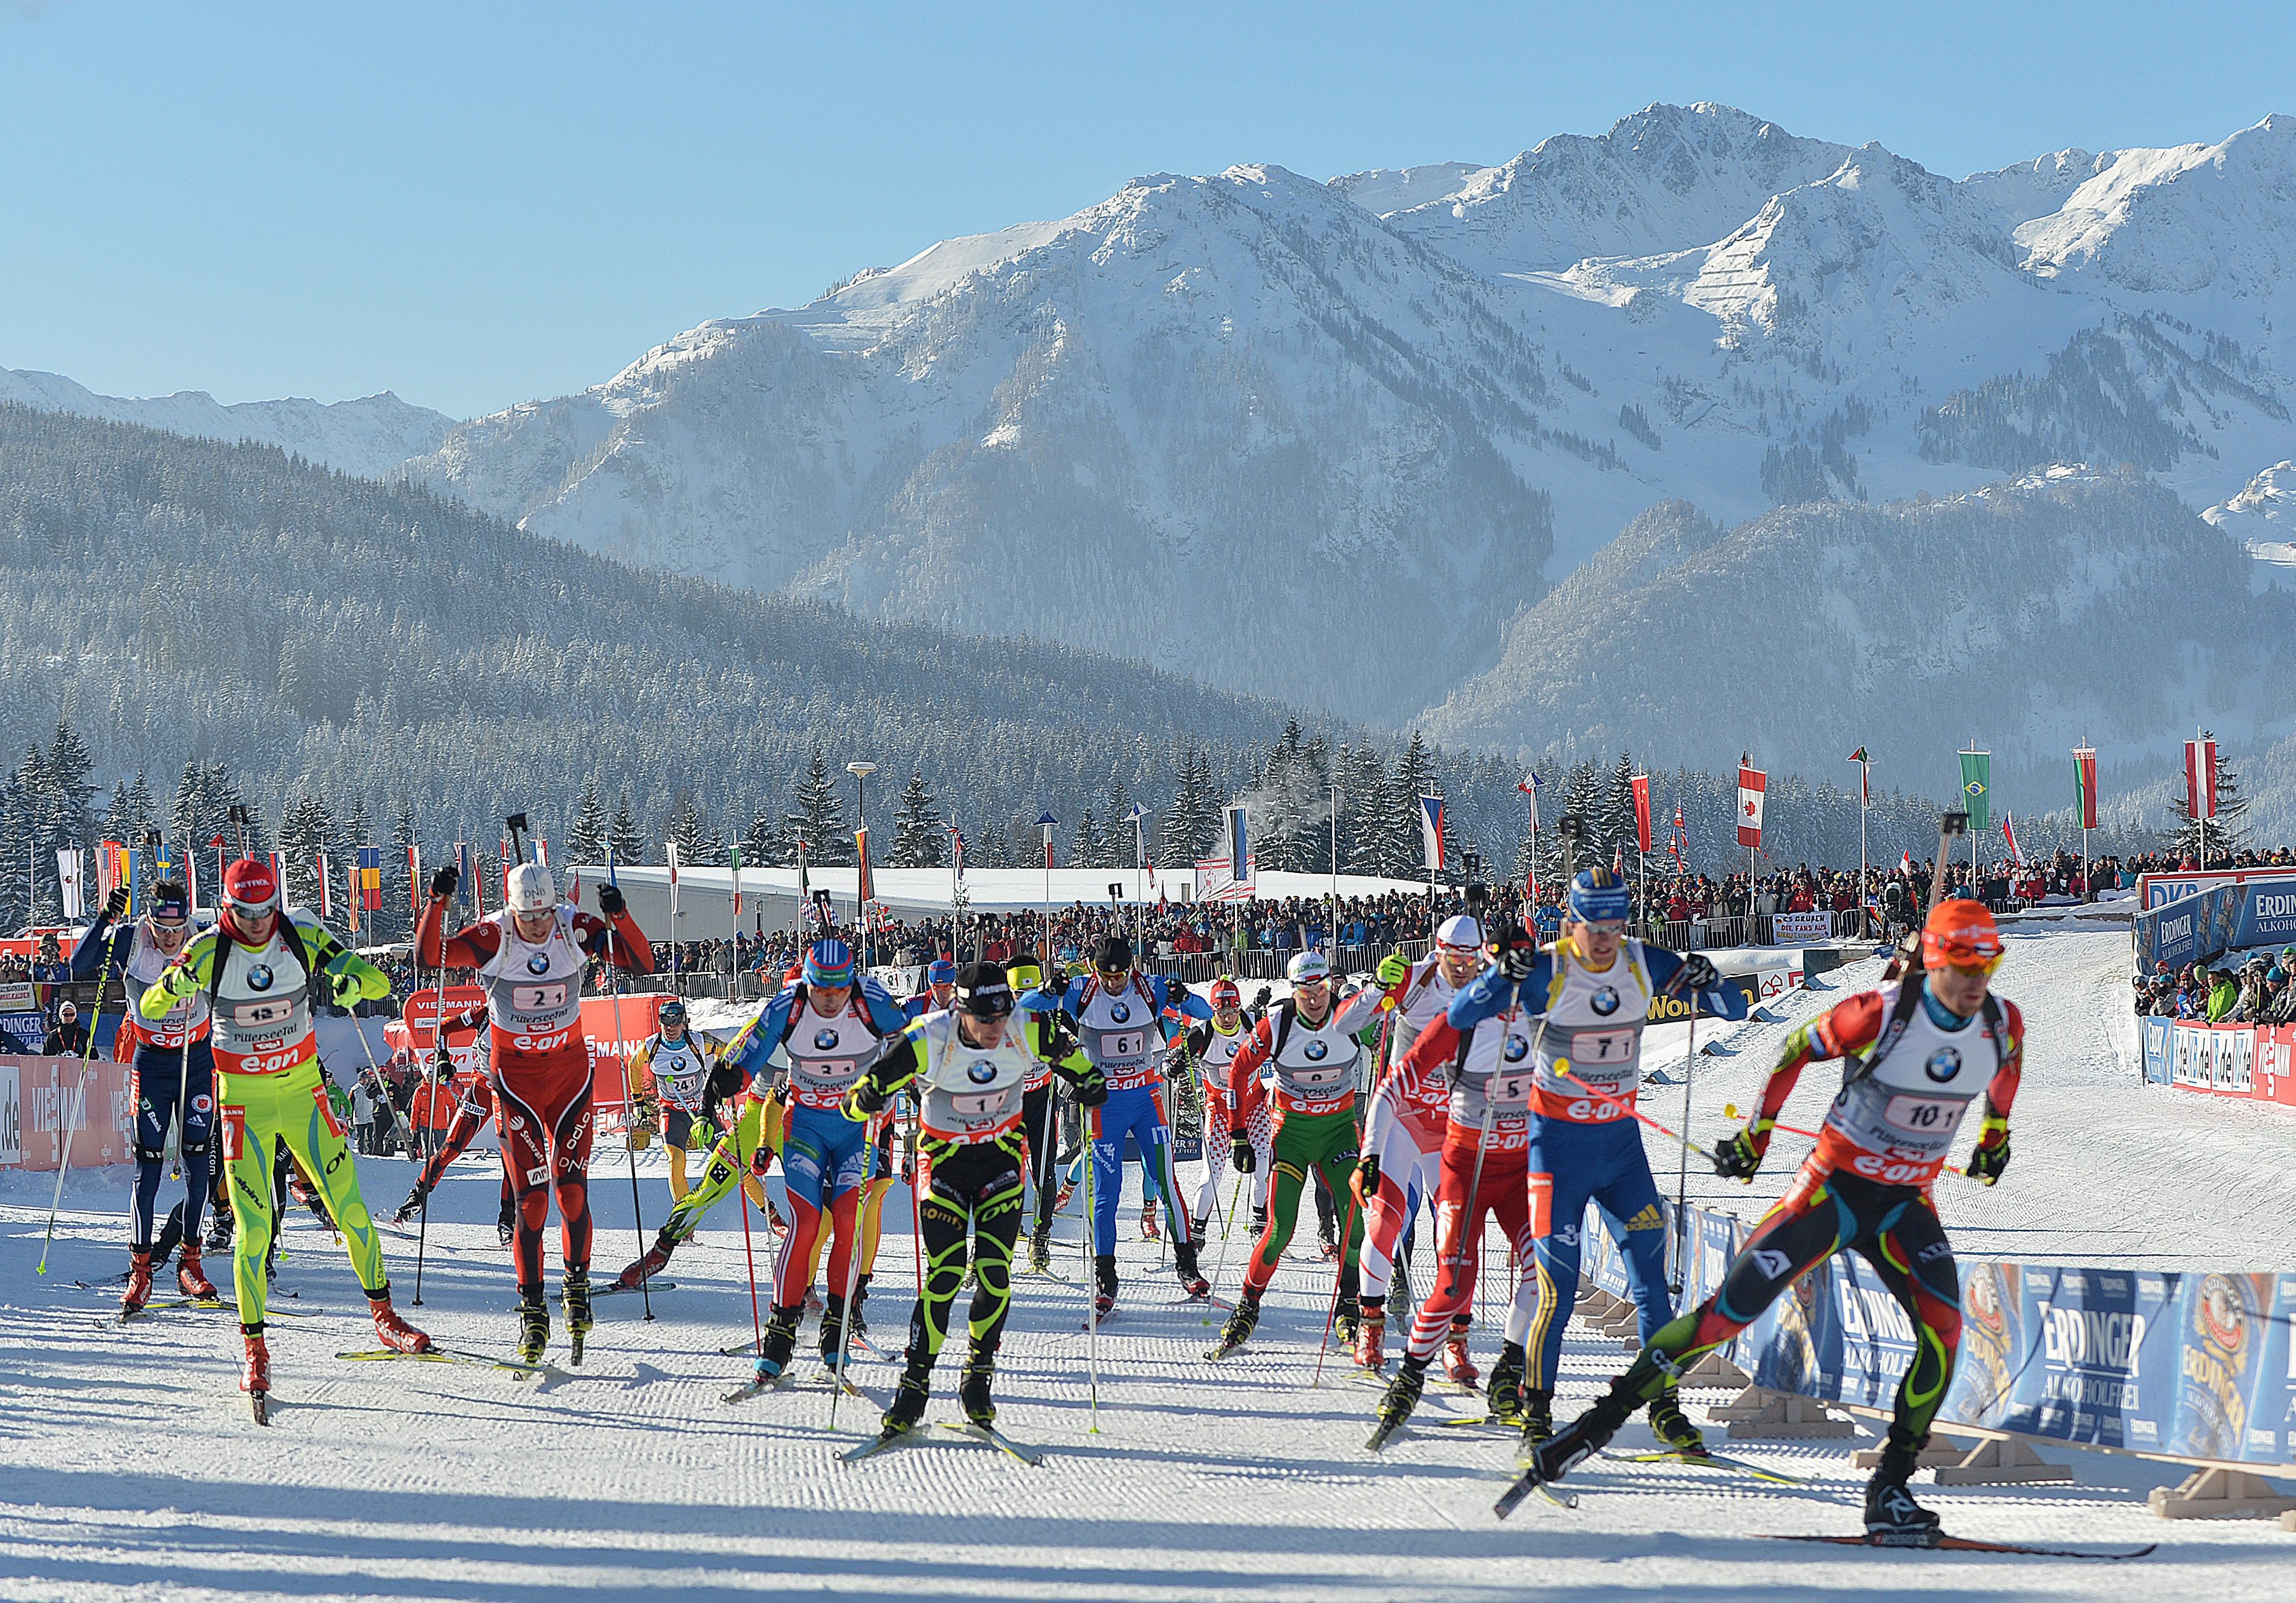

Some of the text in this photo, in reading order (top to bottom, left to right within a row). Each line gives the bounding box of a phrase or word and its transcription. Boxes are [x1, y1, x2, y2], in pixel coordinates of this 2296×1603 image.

[2161, 914, 2193, 944] ERDINGER
[533, 990, 545, 1007] 2
[250, 1007, 273, 1021] 12
[0, 1017, 42, 1034] DINGER
[1117, 1037, 1141, 1053] 6 1
[1598, 1038, 1630, 1058] 7 1
[1507, 1080, 1519, 1098] 5
[1909, 1105, 1938, 1127] 10
[2037, 1300, 2146, 1379] ERDINGER
[1843, 1346, 1914, 1378] ALKOHOLF
[2041, 1374, 2140, 1411] ALKOHOLFREI
